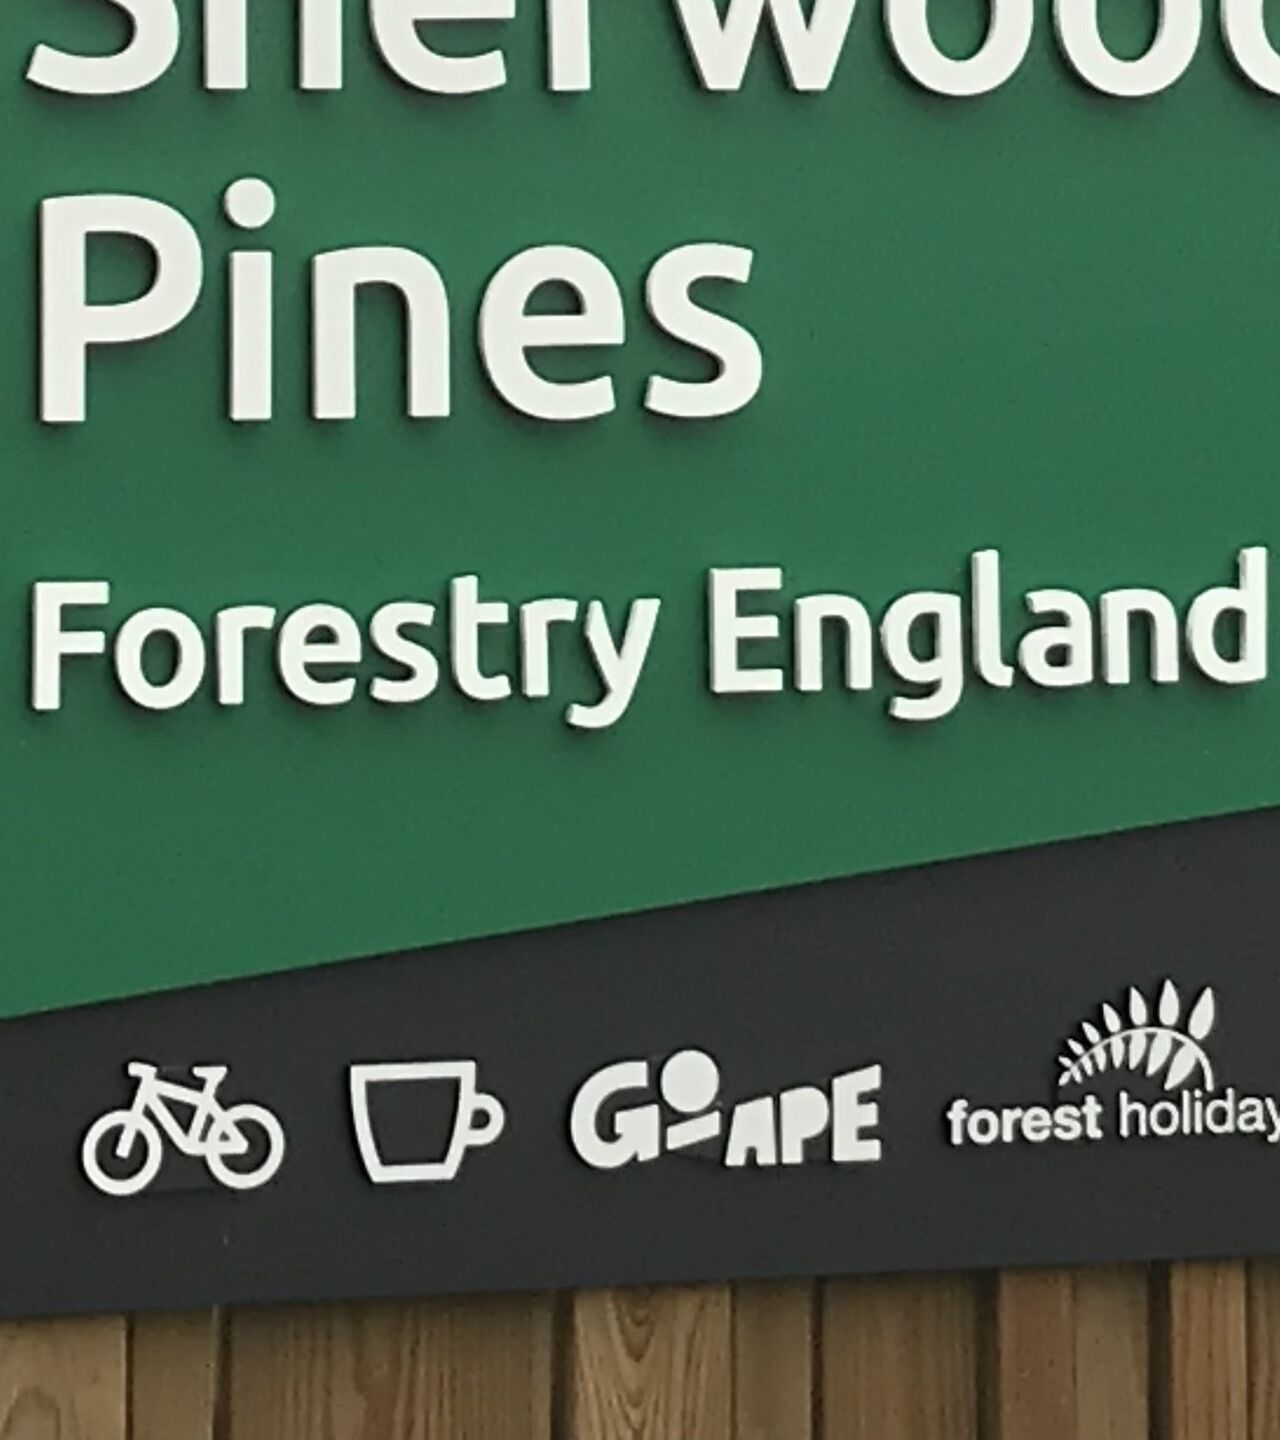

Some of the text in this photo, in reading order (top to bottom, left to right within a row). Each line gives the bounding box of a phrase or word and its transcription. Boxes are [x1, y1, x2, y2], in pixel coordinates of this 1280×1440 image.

[41, 178, 763, 422] Pines
[33, 546, 1268, 729] Forestry England
[947, 1094, 1103, 1145] forest
